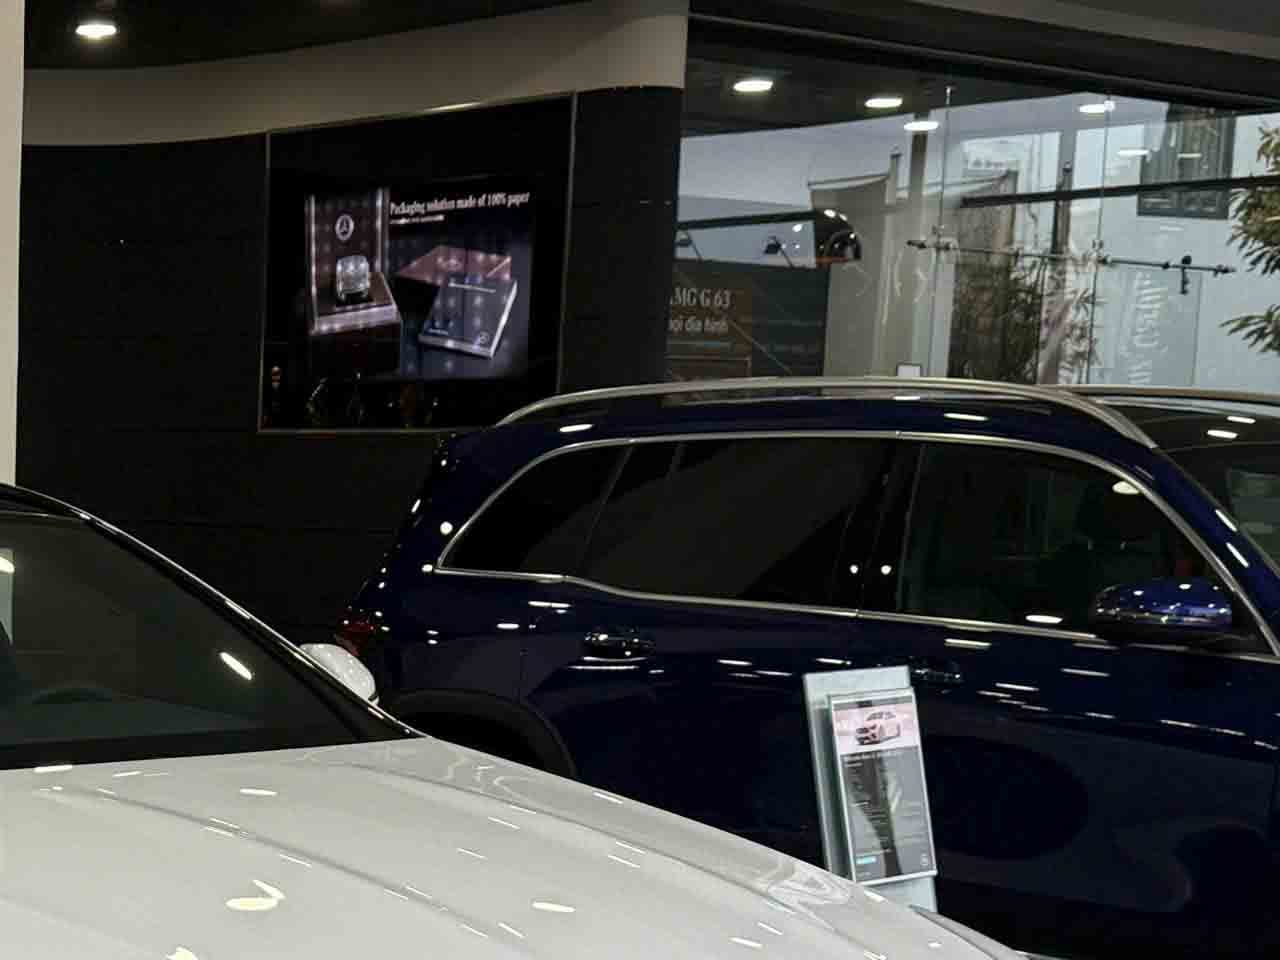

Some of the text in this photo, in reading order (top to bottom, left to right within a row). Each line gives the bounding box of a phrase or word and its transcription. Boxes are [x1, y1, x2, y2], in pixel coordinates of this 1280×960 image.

[390, 192, 531, 216] Packaging solution made of 100% paper
[699, 288, 711, 307] G
[713, 288, 732, 307] 63
